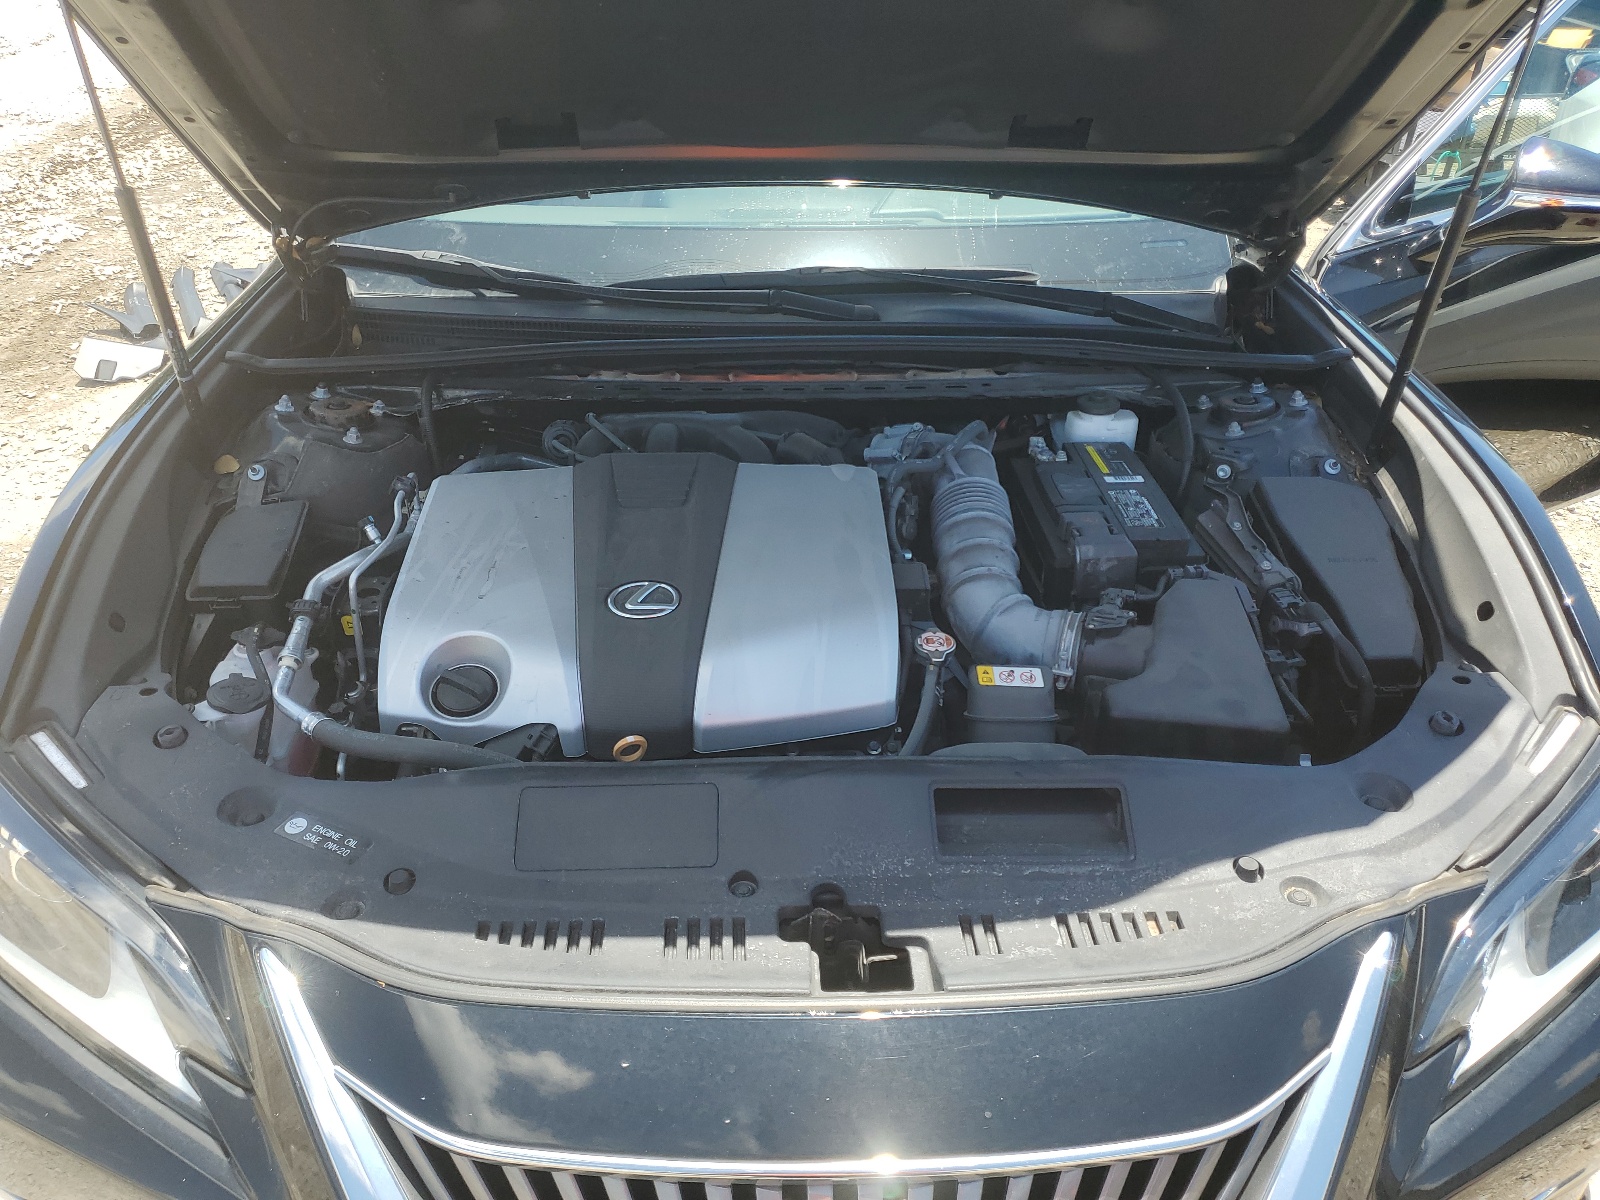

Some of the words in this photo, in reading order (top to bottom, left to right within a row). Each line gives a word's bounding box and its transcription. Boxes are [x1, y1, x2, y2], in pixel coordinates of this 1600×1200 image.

[303, 832, 323, 845] SAE
[323, 841, 351, 857] 0W-20
[311, 824, 344, 841] ENGINE
[344, 838, 359, 849] OIL
